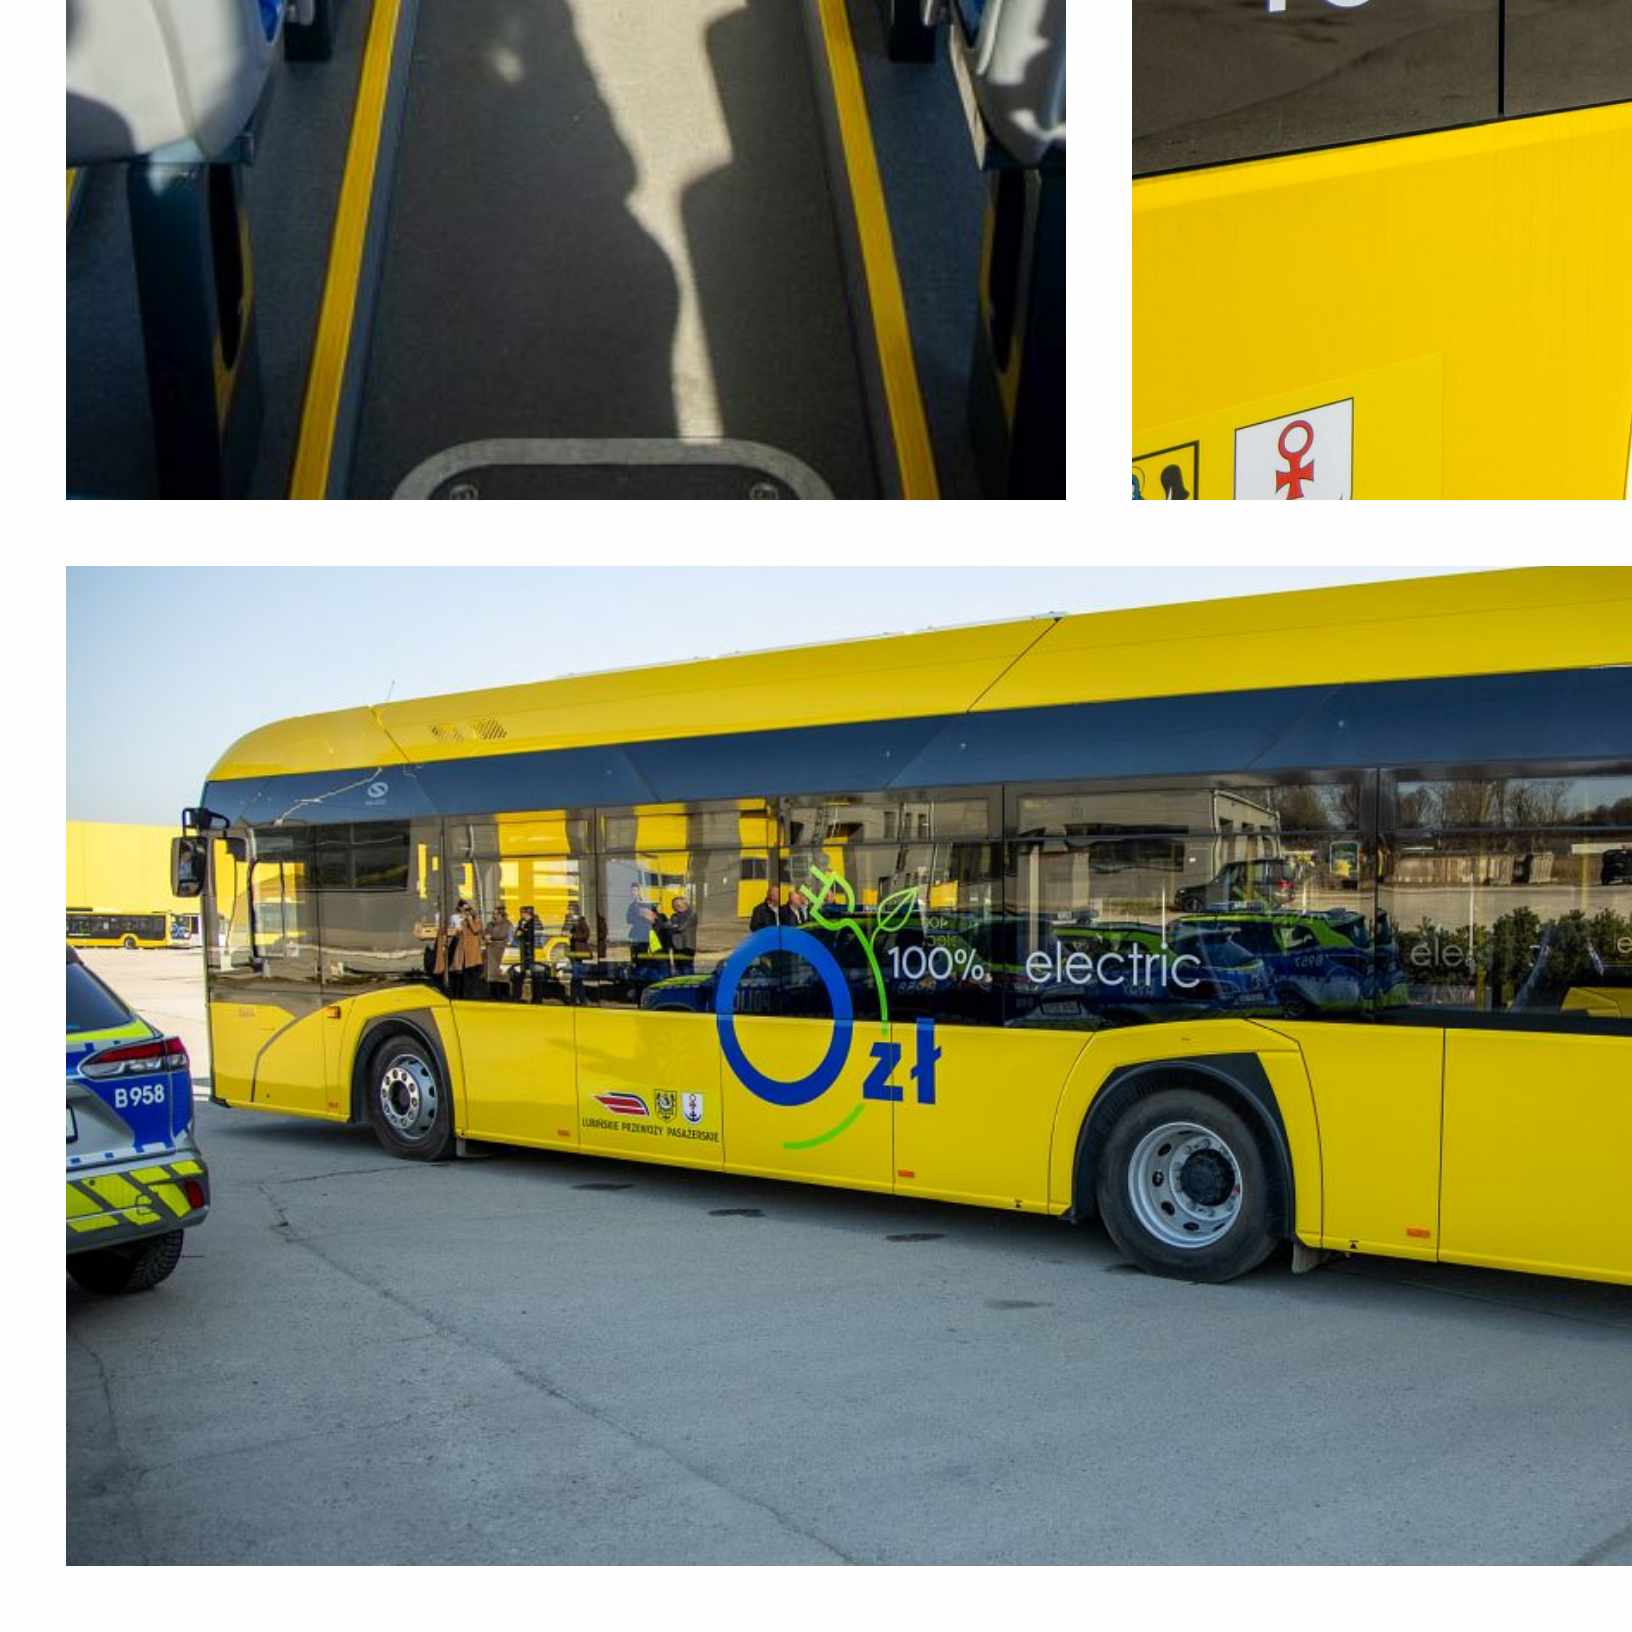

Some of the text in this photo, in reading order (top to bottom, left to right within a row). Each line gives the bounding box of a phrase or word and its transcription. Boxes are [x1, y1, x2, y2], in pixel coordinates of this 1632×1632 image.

[887, 941, 1201, 990] 100% electric
[862, 1018, 942, 1105] zł
[115, 1084, 165, 1108] B958
